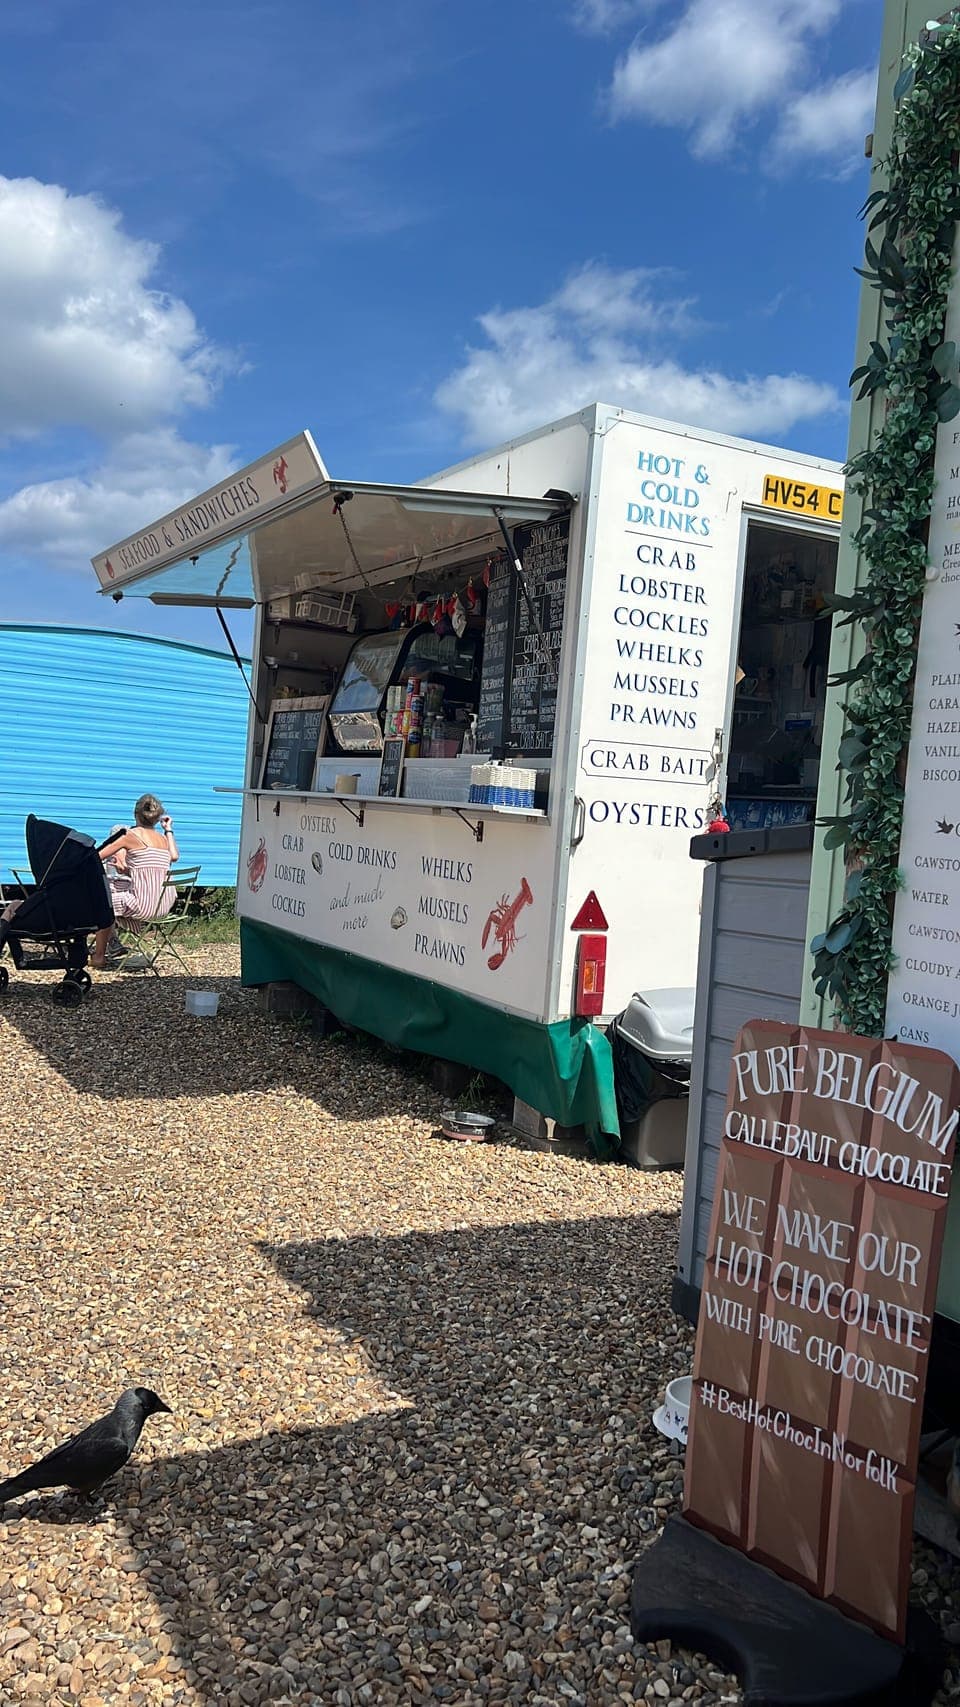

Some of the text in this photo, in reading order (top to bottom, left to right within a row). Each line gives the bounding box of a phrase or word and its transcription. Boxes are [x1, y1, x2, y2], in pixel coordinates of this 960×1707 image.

[637, 450, 711, 485] HOT &
[640, 479, 700, 508] COLD
[764, 477, 842, 515] HV54 C
[118, 476, 260, 570] SEAFOOD & SANDWICHES
[626, 502, 711, 536] DRINKS
[636, 544, 697, 571] CRAB
[618, 573, 707, 604] LOBSTER
[613, 606, 709, 637] COCKLES
[615, 638, 703, 667] WHELKS
[613, 671, 699, 699] MUSSELS
[610, 703, 697, 730] PRAWNS
[590, 750, 708, 776] CRAB BAIT
[300, 814, 337, 834] OYSTERS
[589, 800, 704, 829] OYSTERS
[282, 834, 304, 852] CRAB
[328, 841, 398, 870] COLD DRINKS
[274, 863, 306, 885] LOBSTER
[421, 855, 473, 883] WHELKS
[272, 894, 306, 918] COCKLES
[329, 874, 386, 911] and much
[911, 889, 949, 906] WATER
[342, 915, 369, 931] more
[418, 895, 469, 925] MUSSELS
[415, 933, 466, 966] PRAWNS
[905, 958, 953, 978] CLOUDY
[902, 991, 950, 1013] ORANGE
[900, 1025, 930, 1043] CANS
[731, 1043, 960, 1155] PURE BELGIUM
[725, 1109, 952, 1197] CALLEBAUT CHOCOLATE
[722, 1188, 923, 1287] WE MAKE OUR
[715, 1236, 932, 1354] HOT CHOCOLATE
[705, 1291, 919, 1403] WITH PURE CHOCOLATE
